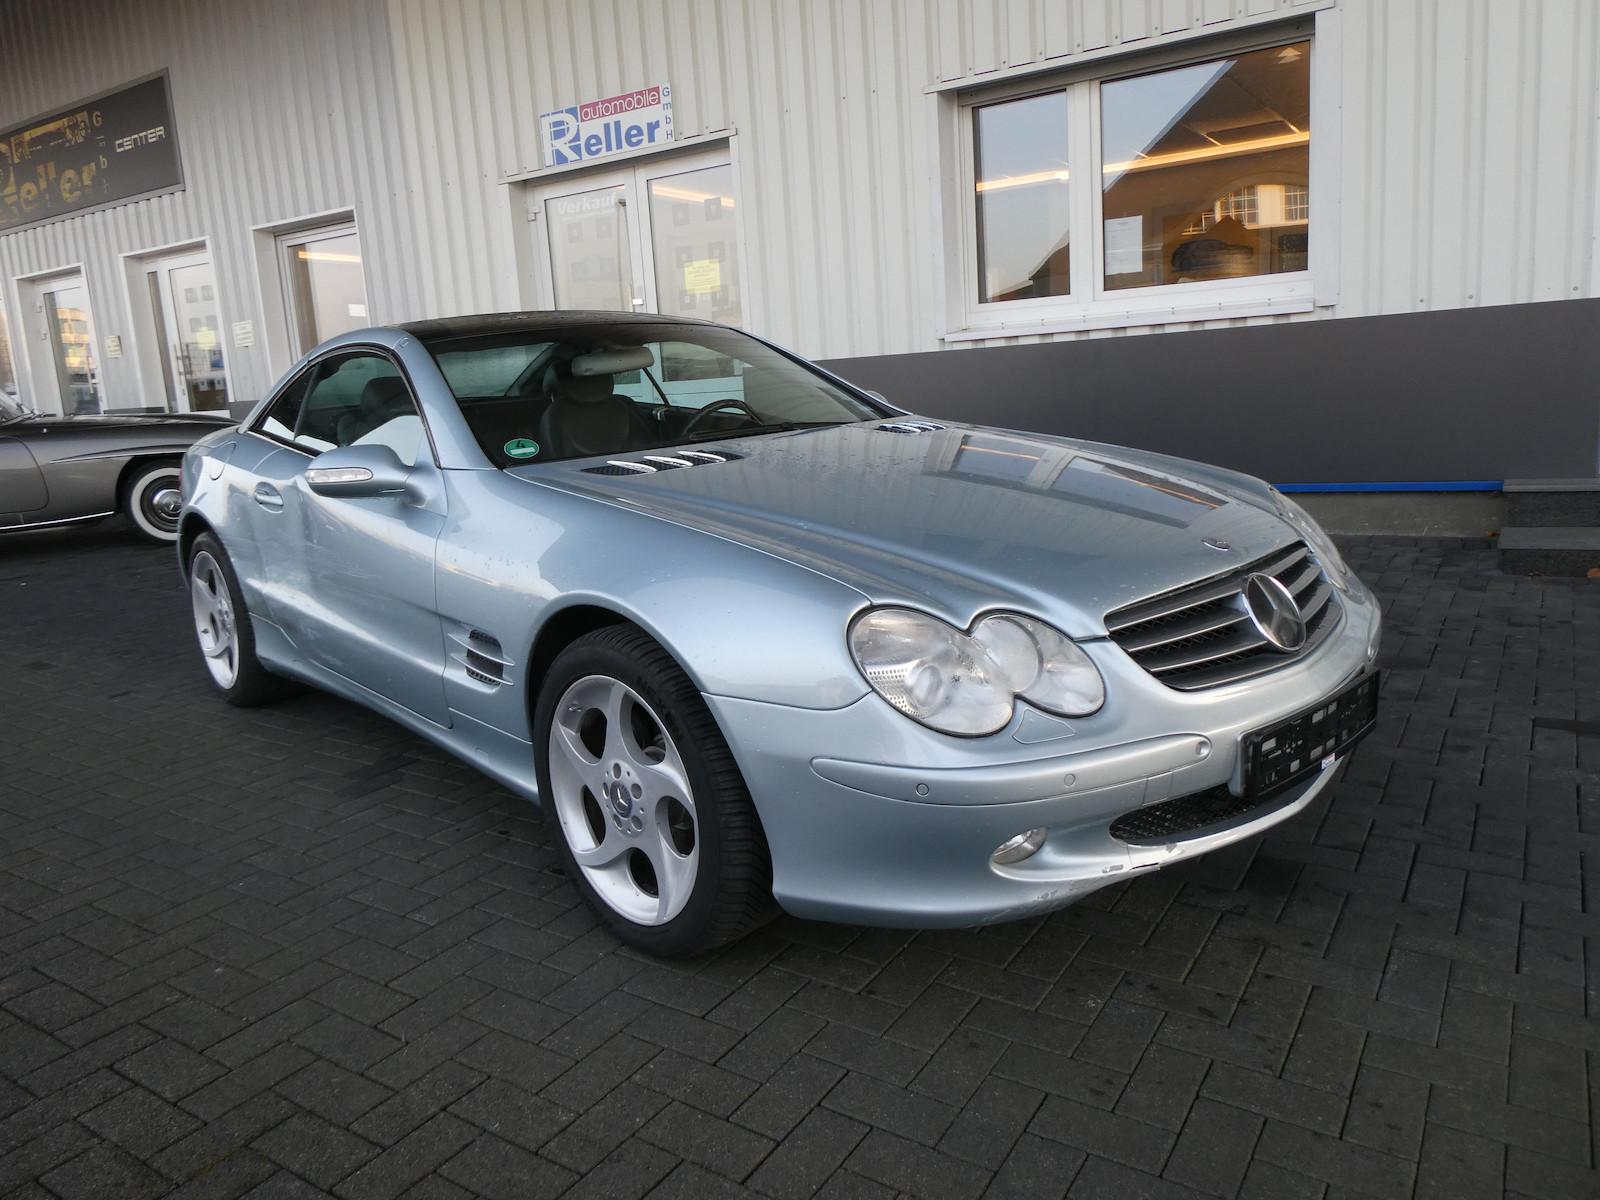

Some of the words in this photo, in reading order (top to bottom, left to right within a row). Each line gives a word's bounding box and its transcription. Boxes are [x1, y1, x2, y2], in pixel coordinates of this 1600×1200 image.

[582, 91, 659, 121] automobile
[115, 126, 166, 152] CENTER
[541, 108, 661, 167] Reller
[558, 192, 616, 214] Verkauf
